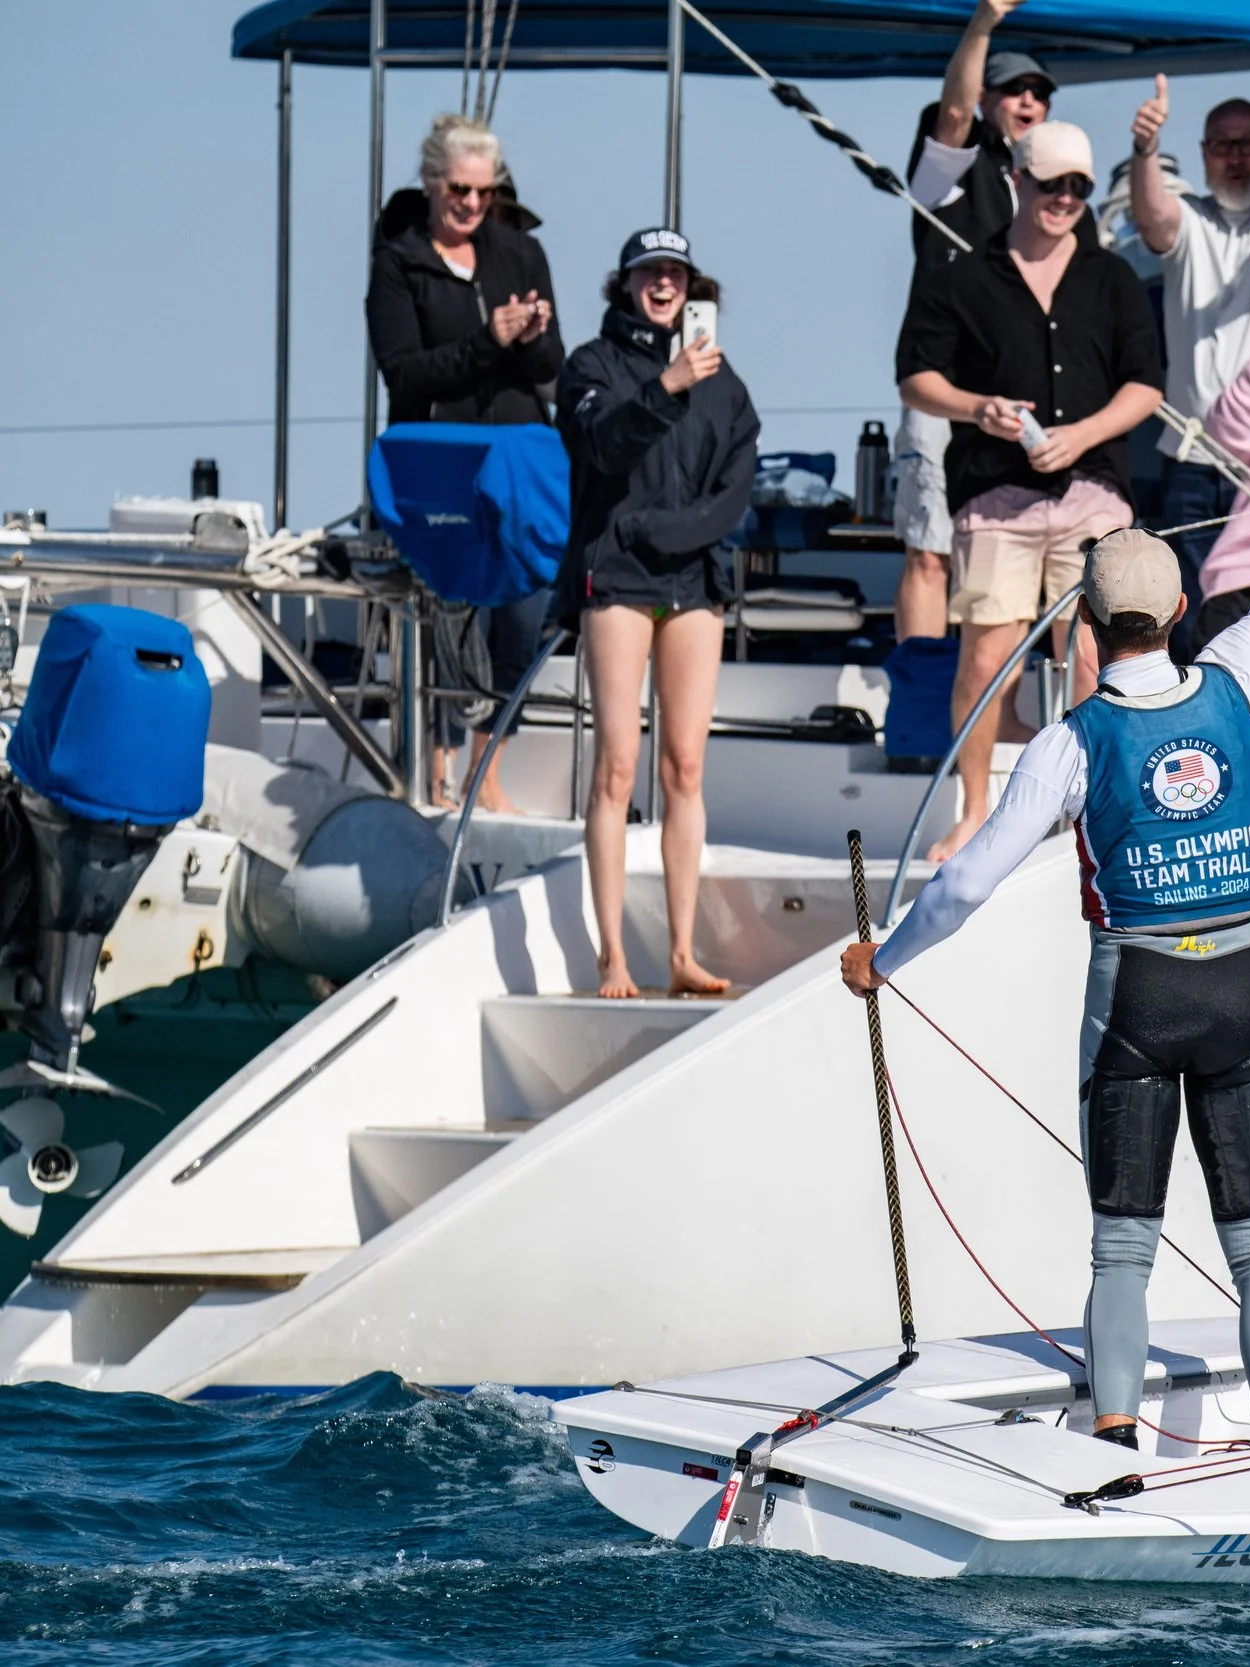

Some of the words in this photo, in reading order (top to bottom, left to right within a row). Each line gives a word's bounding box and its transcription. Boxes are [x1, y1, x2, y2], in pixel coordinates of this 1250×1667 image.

[1146, 742, 1177, 769] UNITED
[1181, 739, 1217, 755] STATES
[1155, 805, 1199, 820] OLYMPIC
[1202, 792, 1225, 814] TEAM
[1126, 843, 1170, 867] U.S.
[1130, 863, 1190, 890] TEAM
[1153, 885, 1208, 906] SAILING
[1221, 877, 1250, 896] 2024
